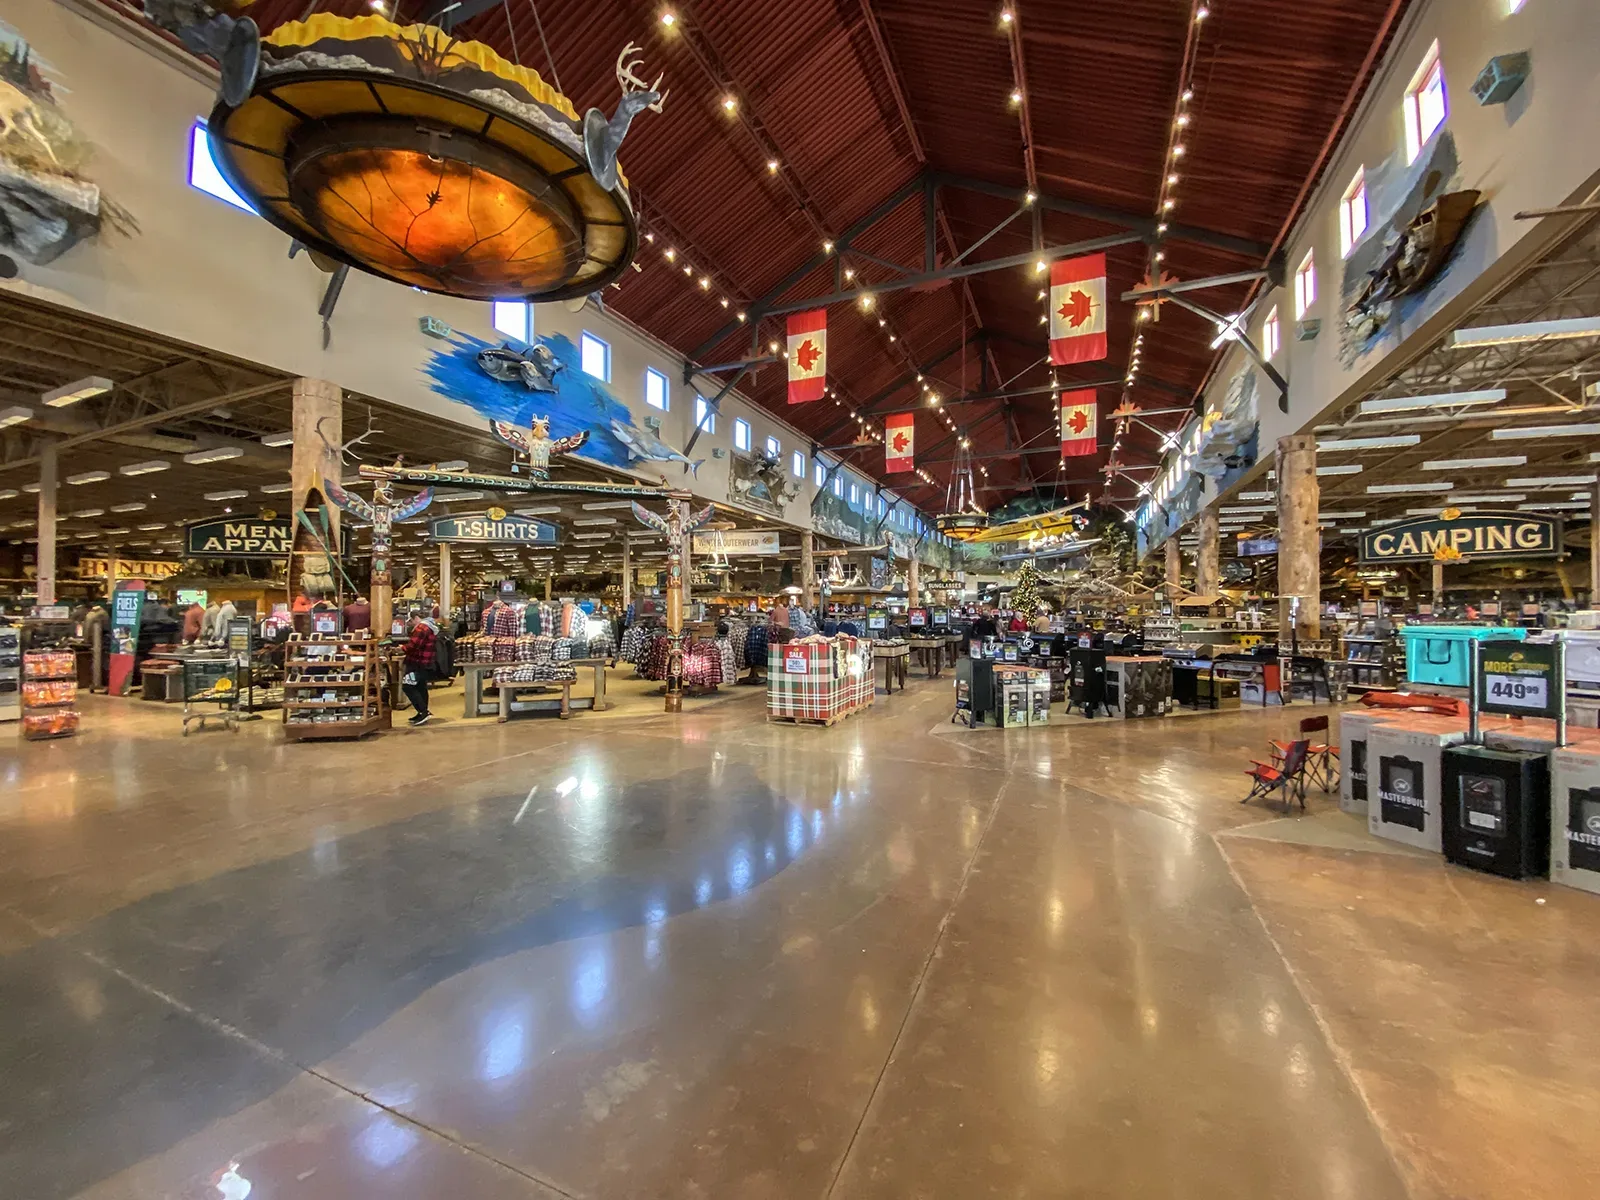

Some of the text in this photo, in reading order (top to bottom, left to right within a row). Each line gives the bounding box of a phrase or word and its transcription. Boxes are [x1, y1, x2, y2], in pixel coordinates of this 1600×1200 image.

[224, 523, 293, 538] MEN
[202, 537, 292, 552] APPAR
[723, 538, 759, 547] OUTERWEAR
[1373, 523, 1543, 556] CAMPING
[81, 560, 184, 577] HNTIN
[116, 597, 139, 611] FUELS
[788, 651, 804, 659] SALE
[1483, 661, 1514, 673] MORE
[1376, 789, 1429, 809] MASTERBUILT
[1563, 829, 1600, 846] MASTE
